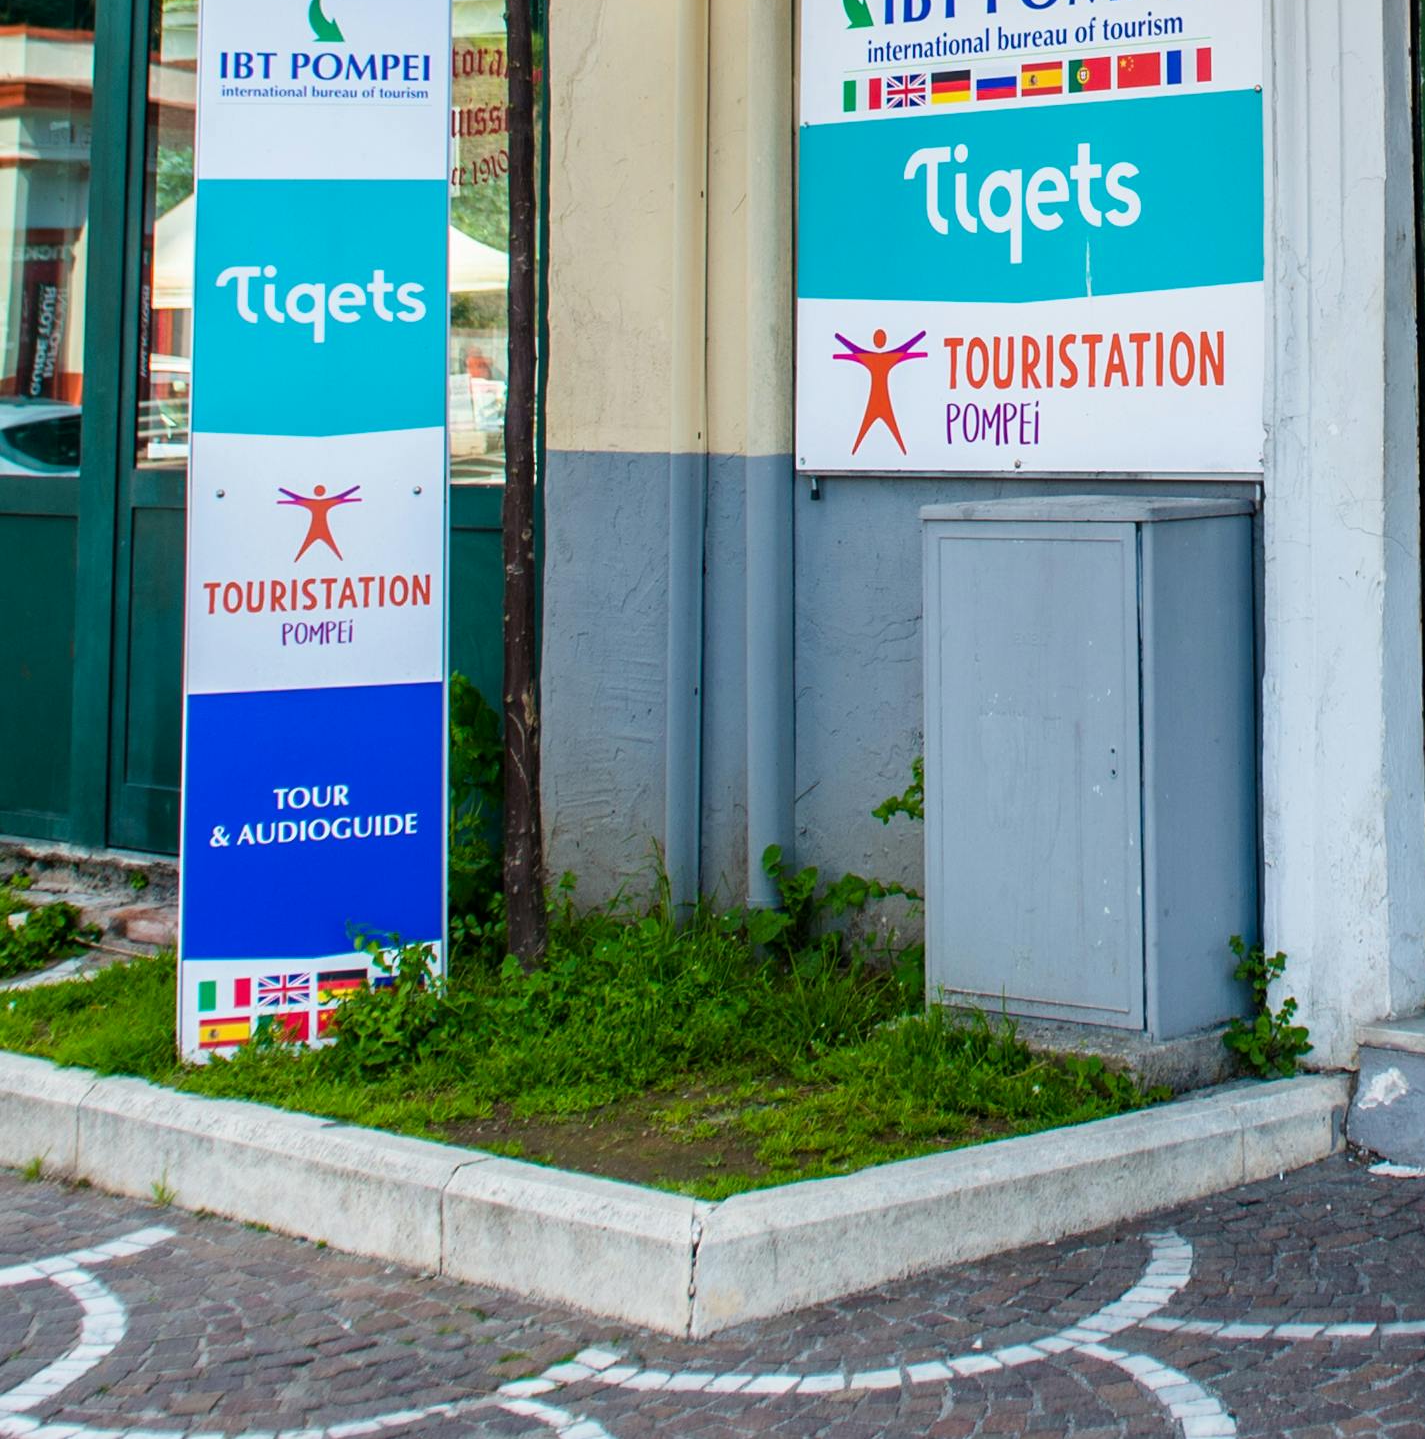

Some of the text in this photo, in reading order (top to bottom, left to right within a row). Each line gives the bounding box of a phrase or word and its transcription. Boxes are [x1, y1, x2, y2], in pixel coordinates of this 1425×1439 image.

[867, 10, 1183, 64] international bureau of tourism
[220, 52, 431, 82] IBT POMPEI
[221, 85, 429, 99] international bureau of tourism
[903, 142, 1142, 264] Tiqets
[215, 265, 428, 344] Tiqets
[943, 329, 1225, 390] TOURISTATION
[203, 574, 432, 615] TOURISTATION
[273, 784, 350, 811] TOUR
[210, 812, 418, 848] & AUDIOGUIDE
